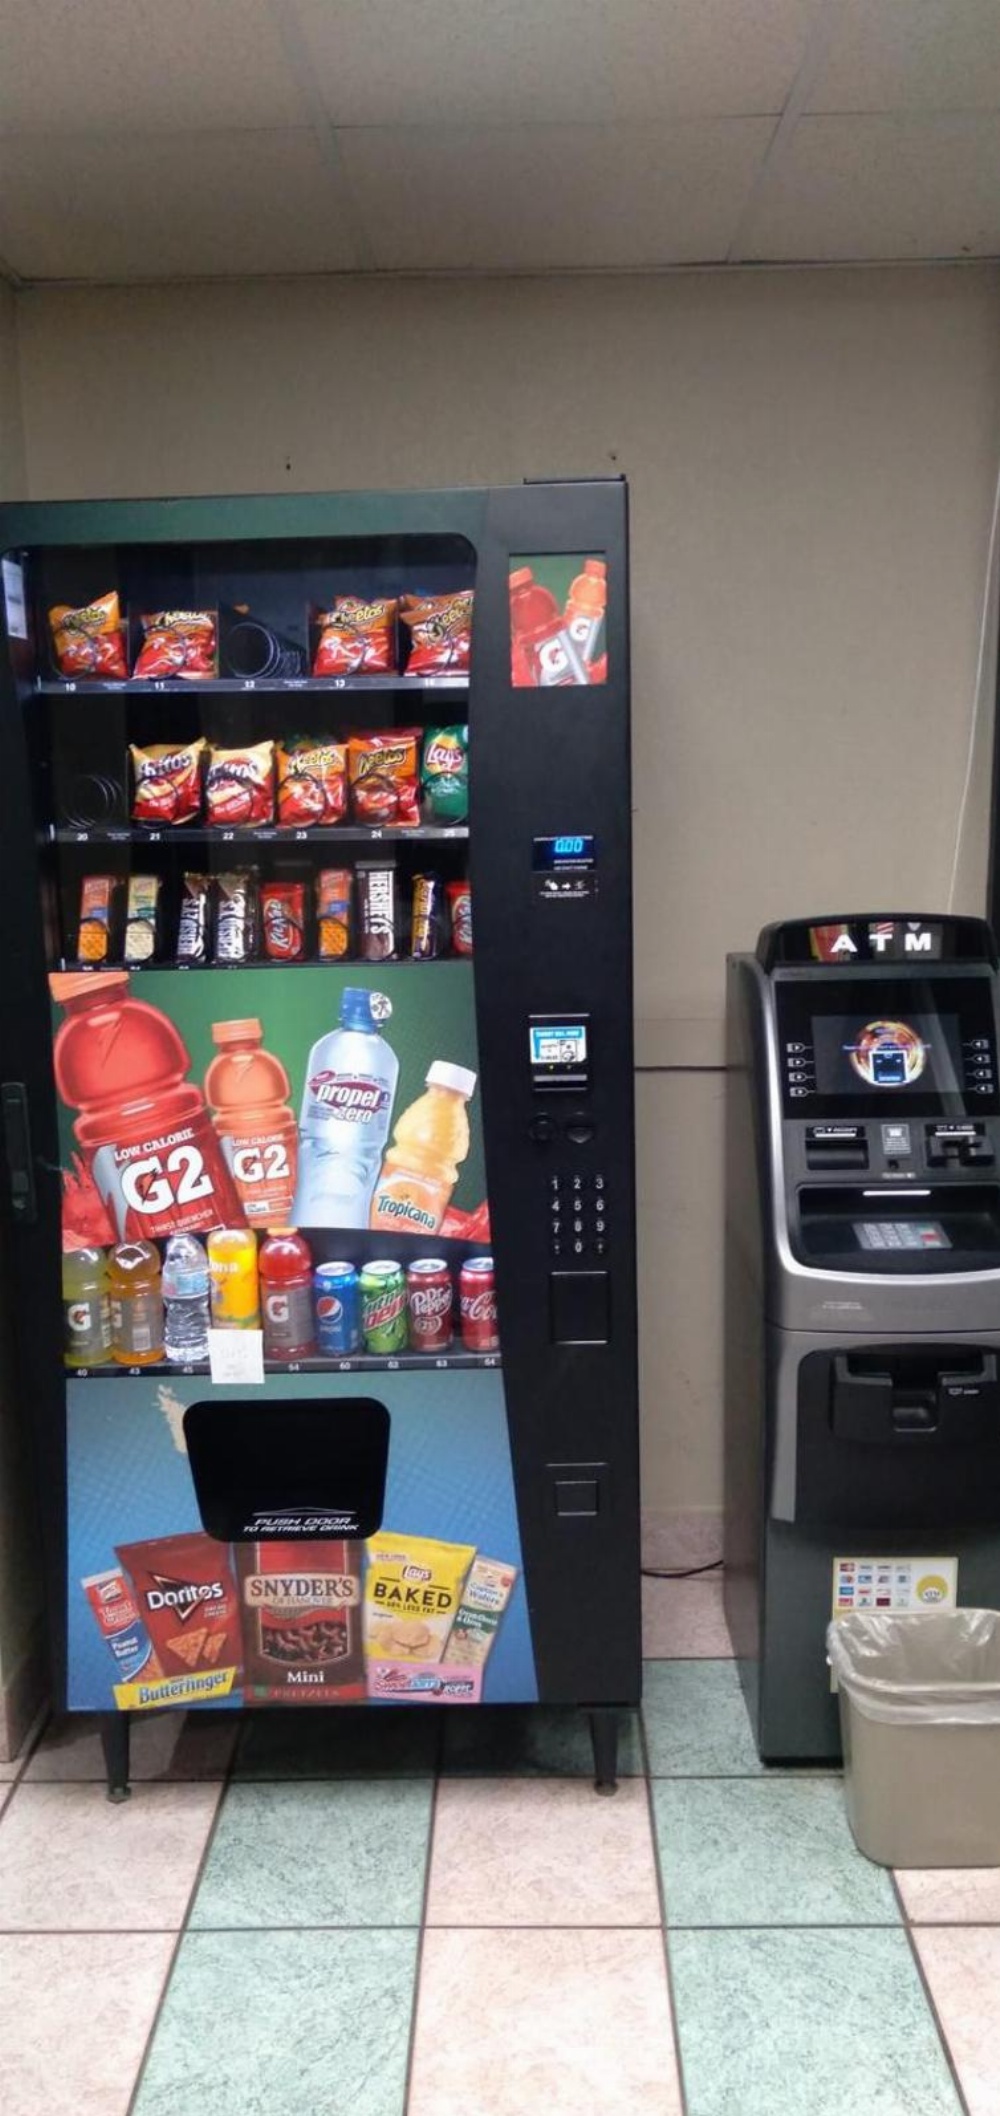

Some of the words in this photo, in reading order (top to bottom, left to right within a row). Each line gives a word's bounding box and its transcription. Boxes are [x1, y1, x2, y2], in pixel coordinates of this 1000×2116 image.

[224, 832, 235, 840] 22
[297, 831, 308, 840] 23
[372, 830, 383, 838] 24
[830, 933, 931, 953] ATM
[317, 1083, 381, 1110] propel
[336, 1105, 374, 1125] zero
[115, 1147, 142, 1162] LOW
[144, 1129, 197, 1155] CALORIE
[234, 1143, 290, 1185] G2
[122, 1145, 216, 1216] G2
[552, 1178, 558, 1190] 1
[574, 1177, 581, 1189] 2
[596, 1176, 604, 1189] 3
[377, 1195, 436, 1229] Tropicana
[552, 1200, 560, 1211] 4
[574, 1200, 582, 1211] 5
[596, 1199, 604, 1211] 6
[552, 1221, 560, 1234] 7
[574, 1221, 582, 1232] 8
[596, 1220, 605, 1232] 9
[575, 1241, 582, 1253] 0
[68, 1303, 92, 1332] G
[267, 1295, 290, 1323] G
[78, 1369, 89, 1378] 40
[340, 1361, 351, 1370] 60
[255, 1517, 302, 1527] PUSH
[304, 1517, 352, 1525] DOOR
[260, 1525, 318, 1533] RETRIEVE
[320, 1524, 360, 1532] DRINK
[251, 1577, 354, 1598] SNYDER'S
[373, 1582, 453, 1610] BAKED
[146, 1582, 225, 1611] Doritos
[422, 1606, 436, 1615] FAT
[287, 1671, 326, 1683] Mini
[138, 1672, 229, 1704] Butterfinger
